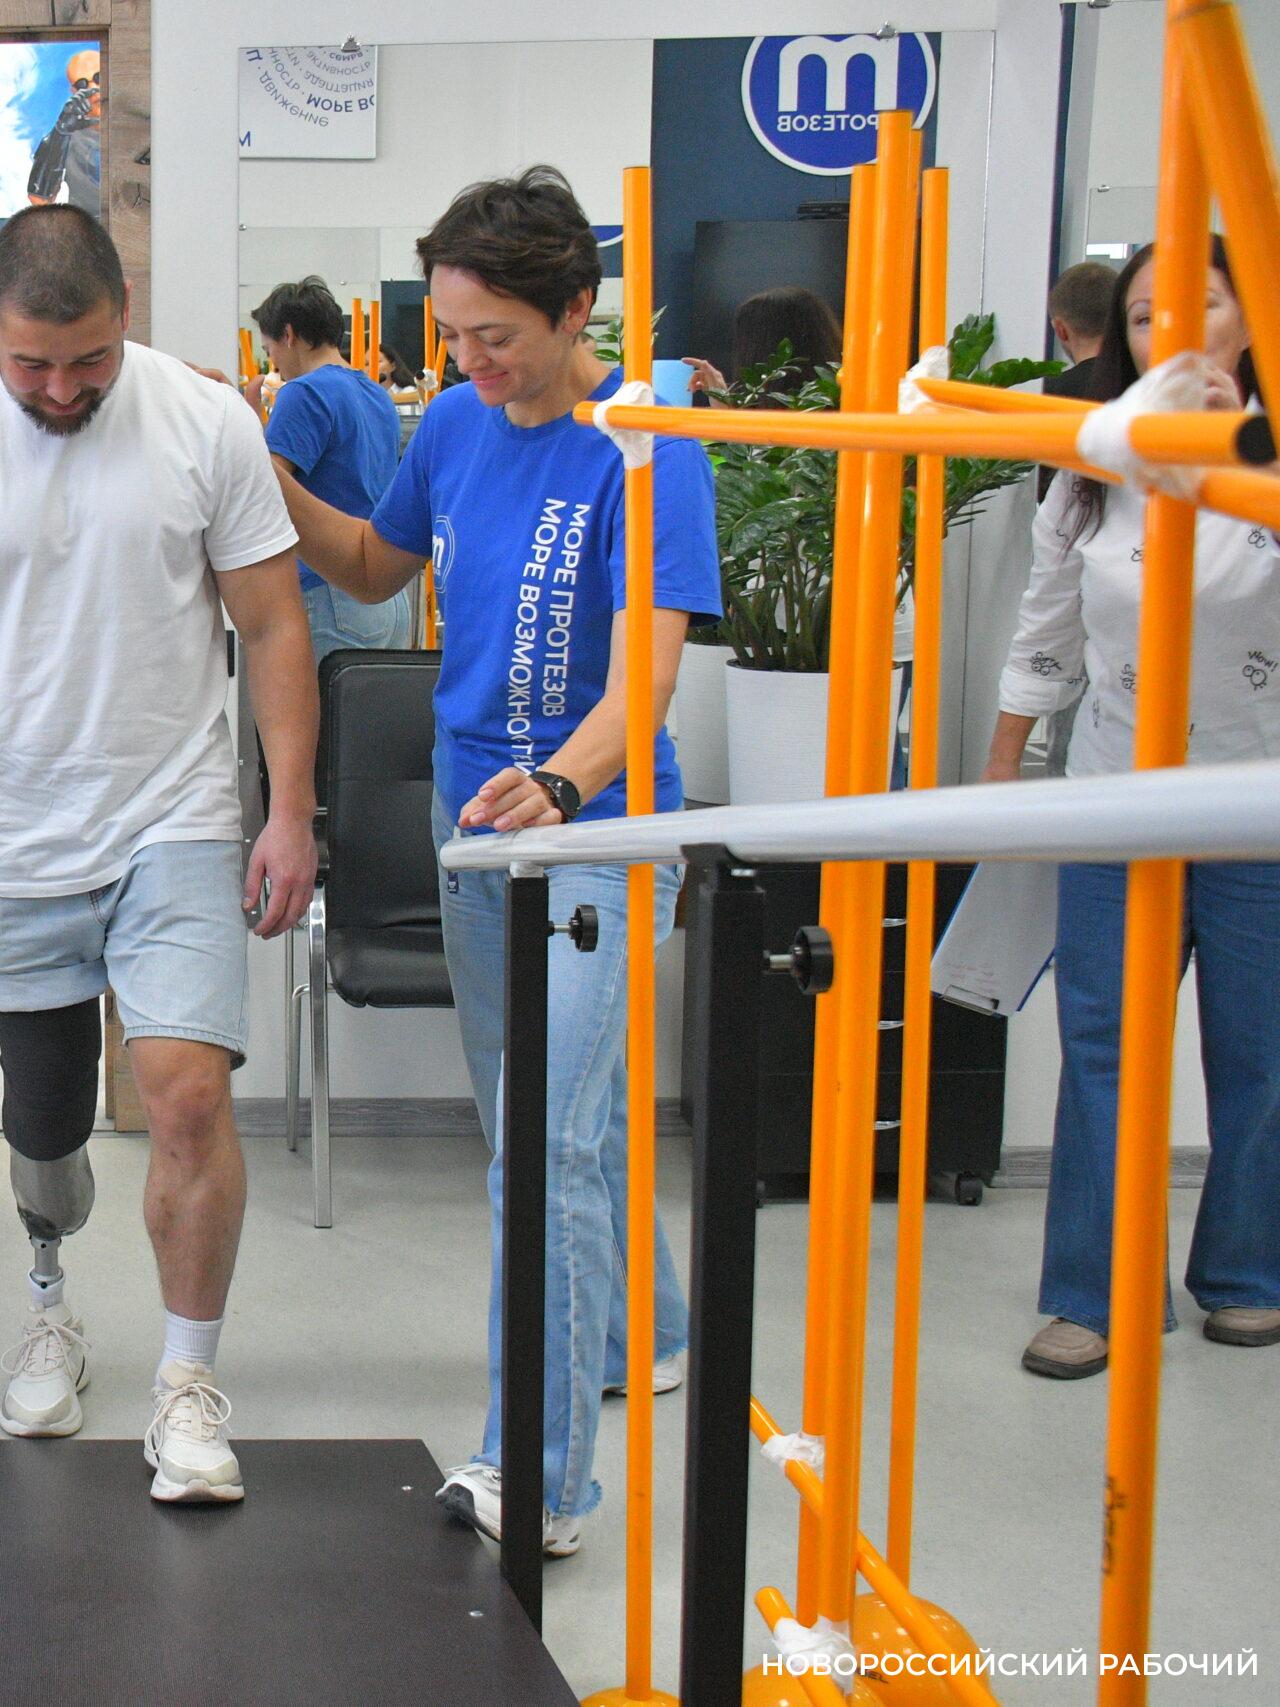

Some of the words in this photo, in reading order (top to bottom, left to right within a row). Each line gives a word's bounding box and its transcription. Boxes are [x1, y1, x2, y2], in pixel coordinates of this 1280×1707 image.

[523, 498, 567, 581] МОРЕ
[561, 503, 591, 586] МОРЕ
[542, 590, 575, 718] ПРОТЕЗОВ
